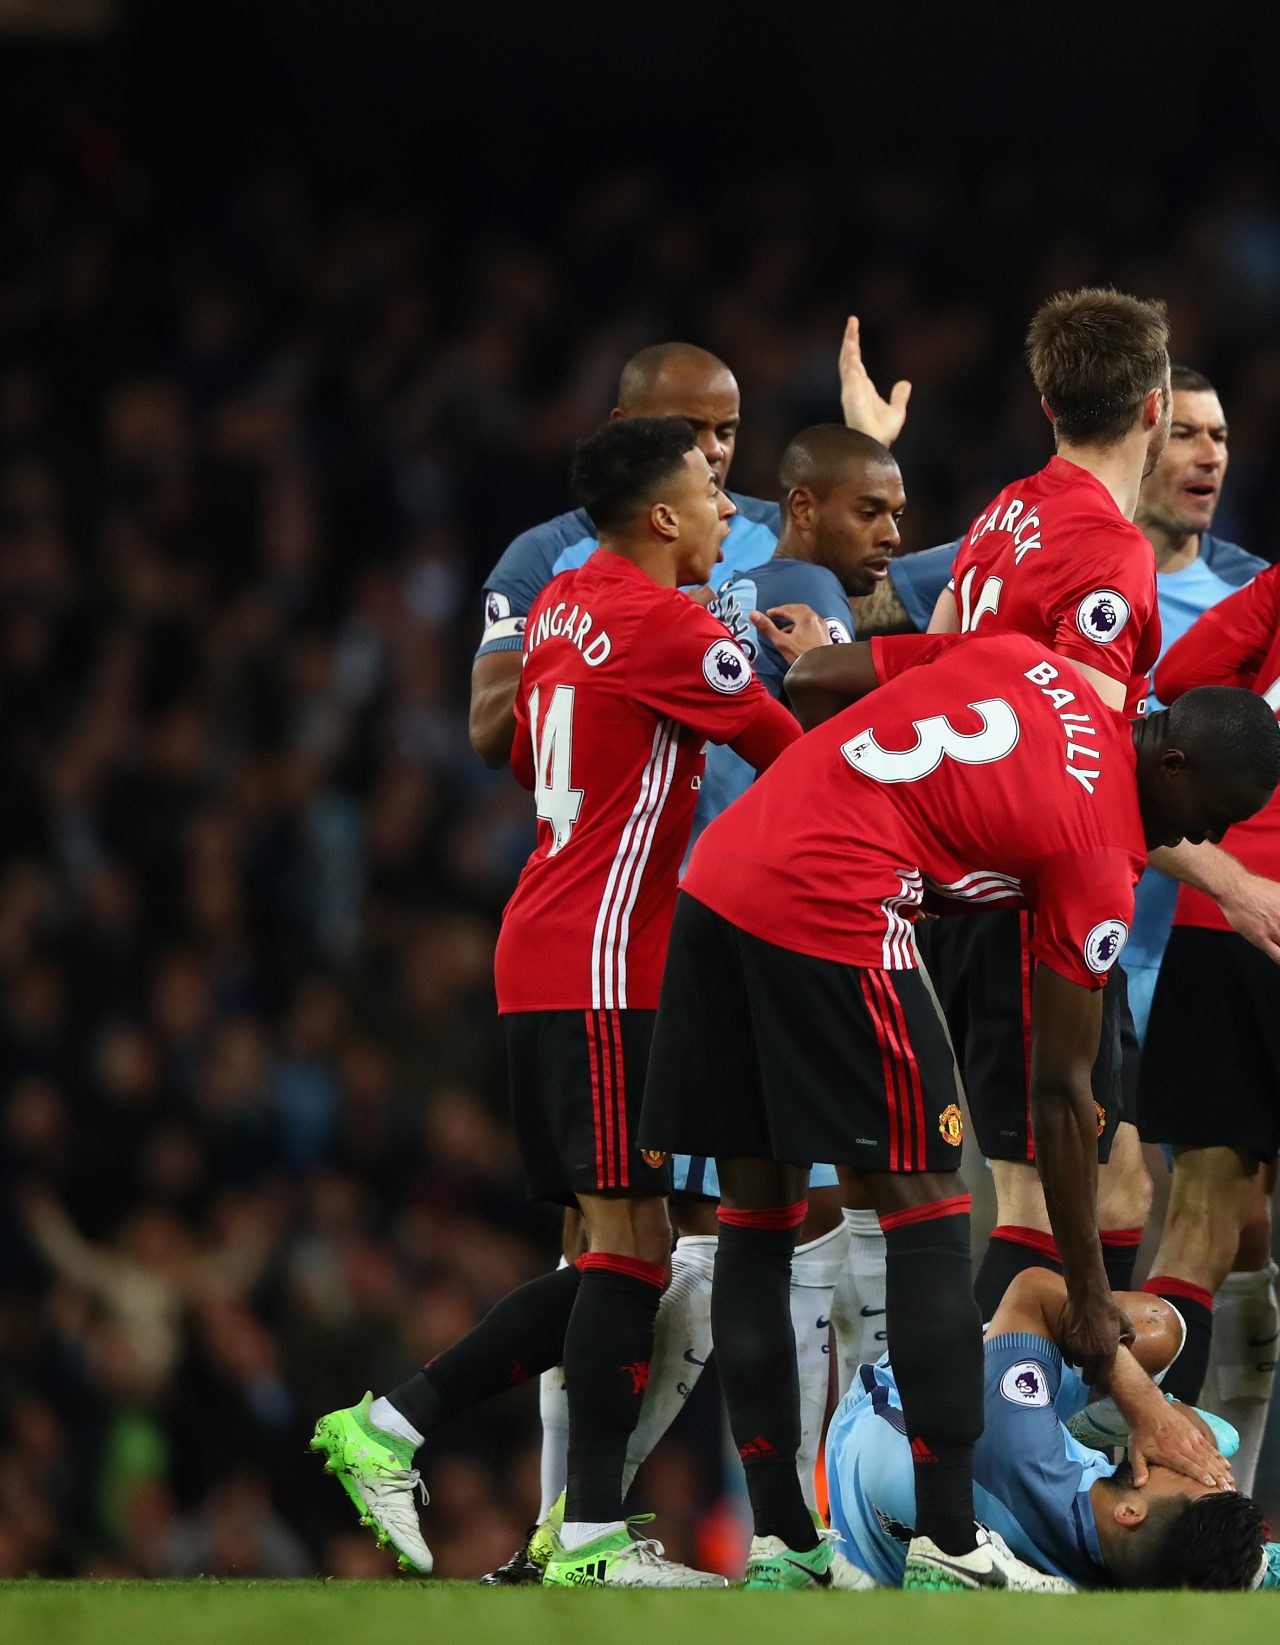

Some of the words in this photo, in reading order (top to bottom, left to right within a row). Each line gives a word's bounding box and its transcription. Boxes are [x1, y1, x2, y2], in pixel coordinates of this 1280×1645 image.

[522, 602, 612, 668] INGARD
[839, 697, 1021, 785] 3
[1023, 660, 1101, 795] BAILLY
